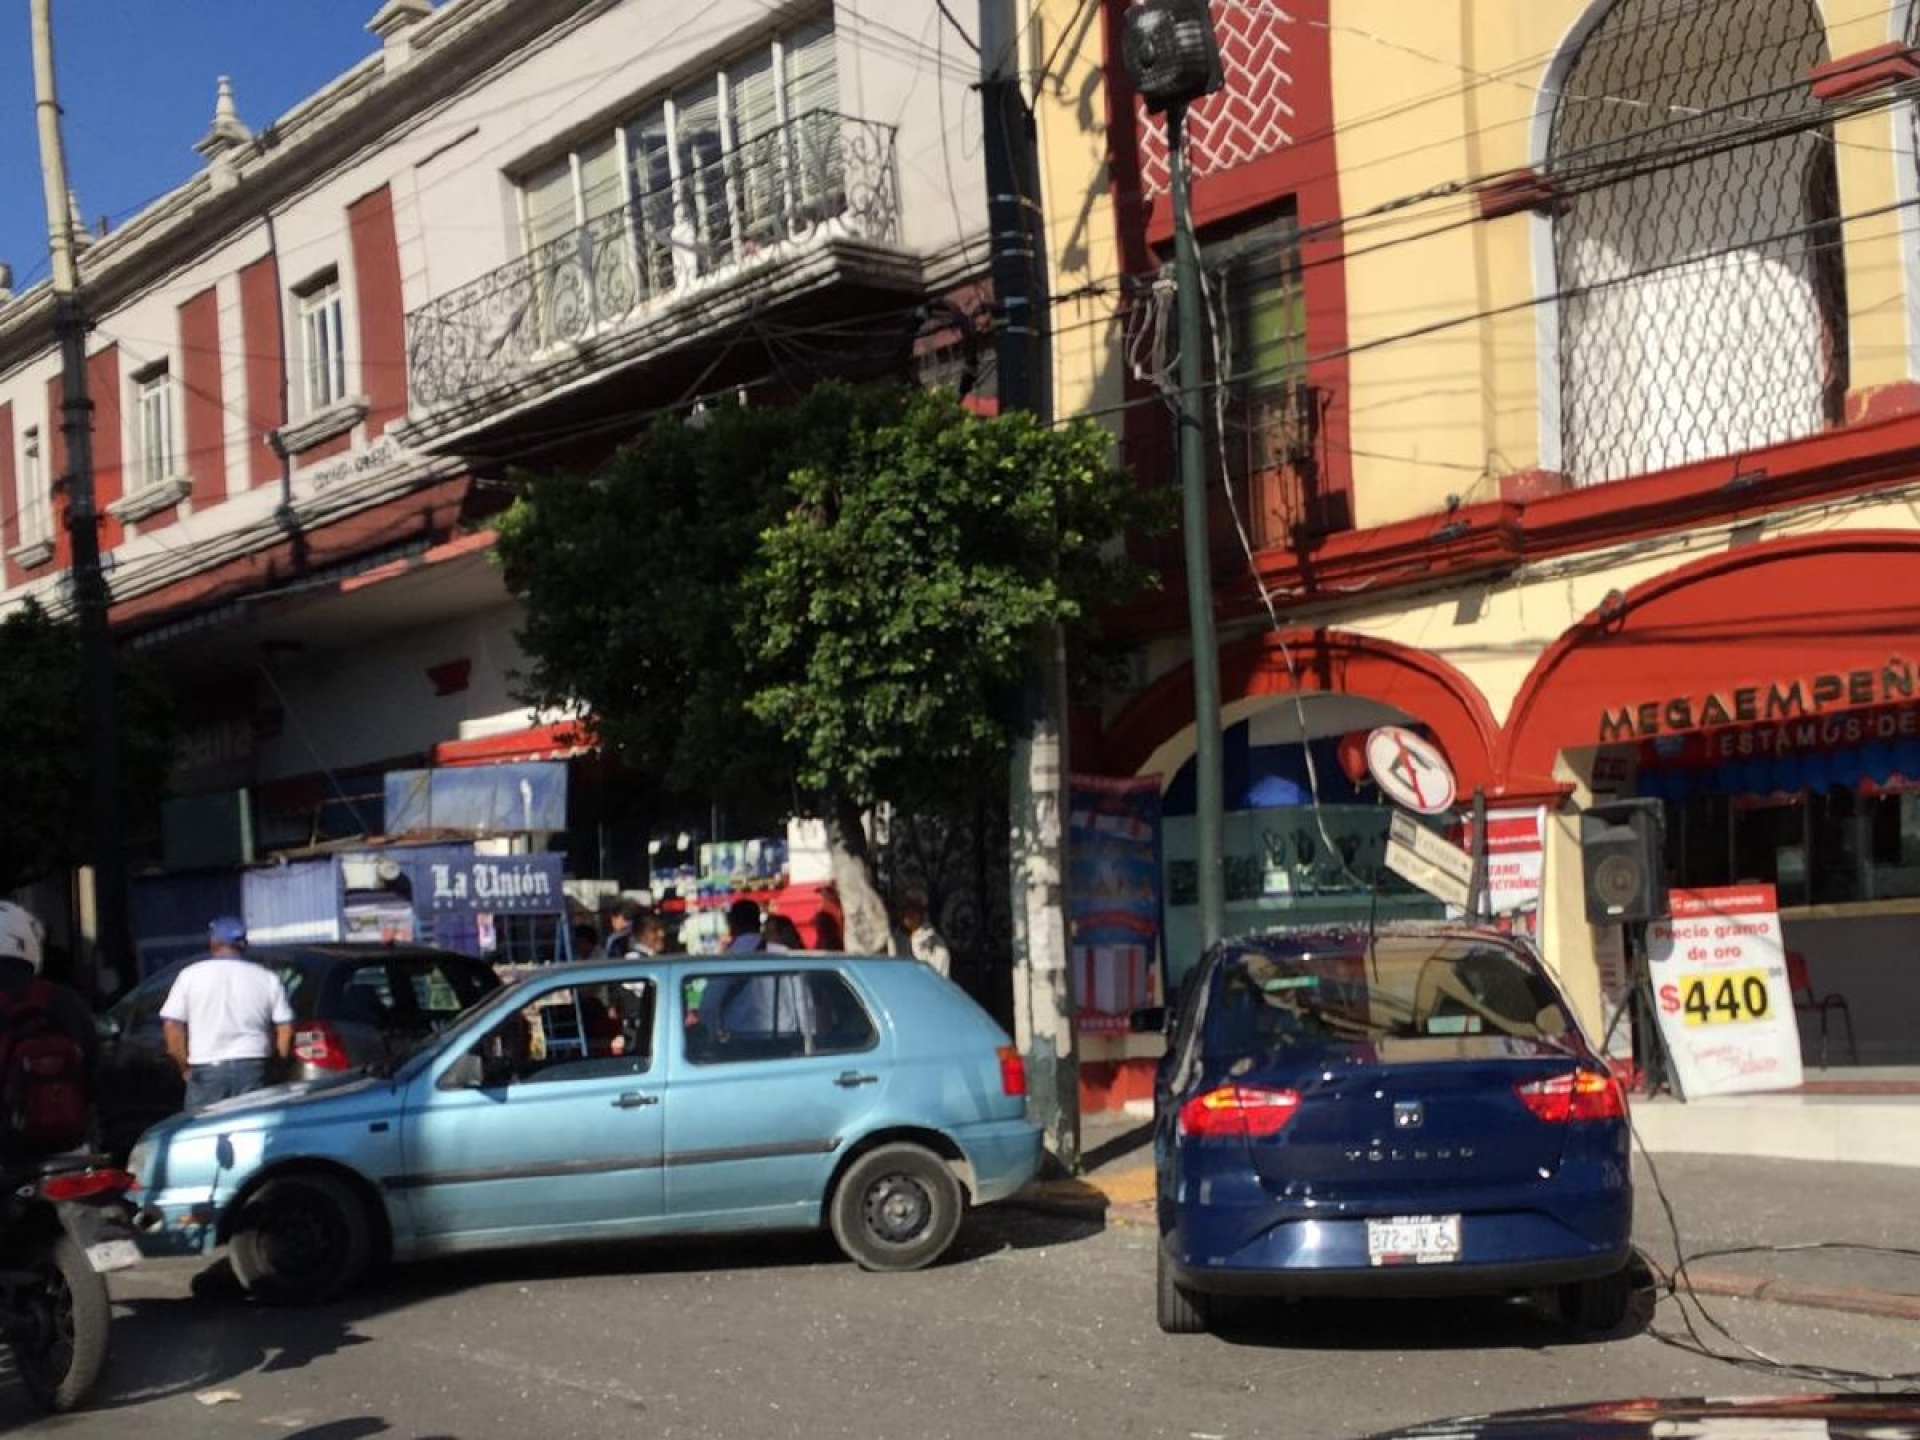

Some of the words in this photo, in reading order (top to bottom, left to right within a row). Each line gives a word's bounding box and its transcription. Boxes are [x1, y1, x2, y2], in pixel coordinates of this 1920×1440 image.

[1599, 656, 1920, 742] MEGAEMPEÑ
[431, 864, 467, 899] La
[473, 864, 549, 898] Unión
[1654, 924, 1709, 941] Precio
[1714, 921, 1769, 939] gramo
[1687, 946, 1707, 960] de
[1714, 946, 1741, 958] oro
